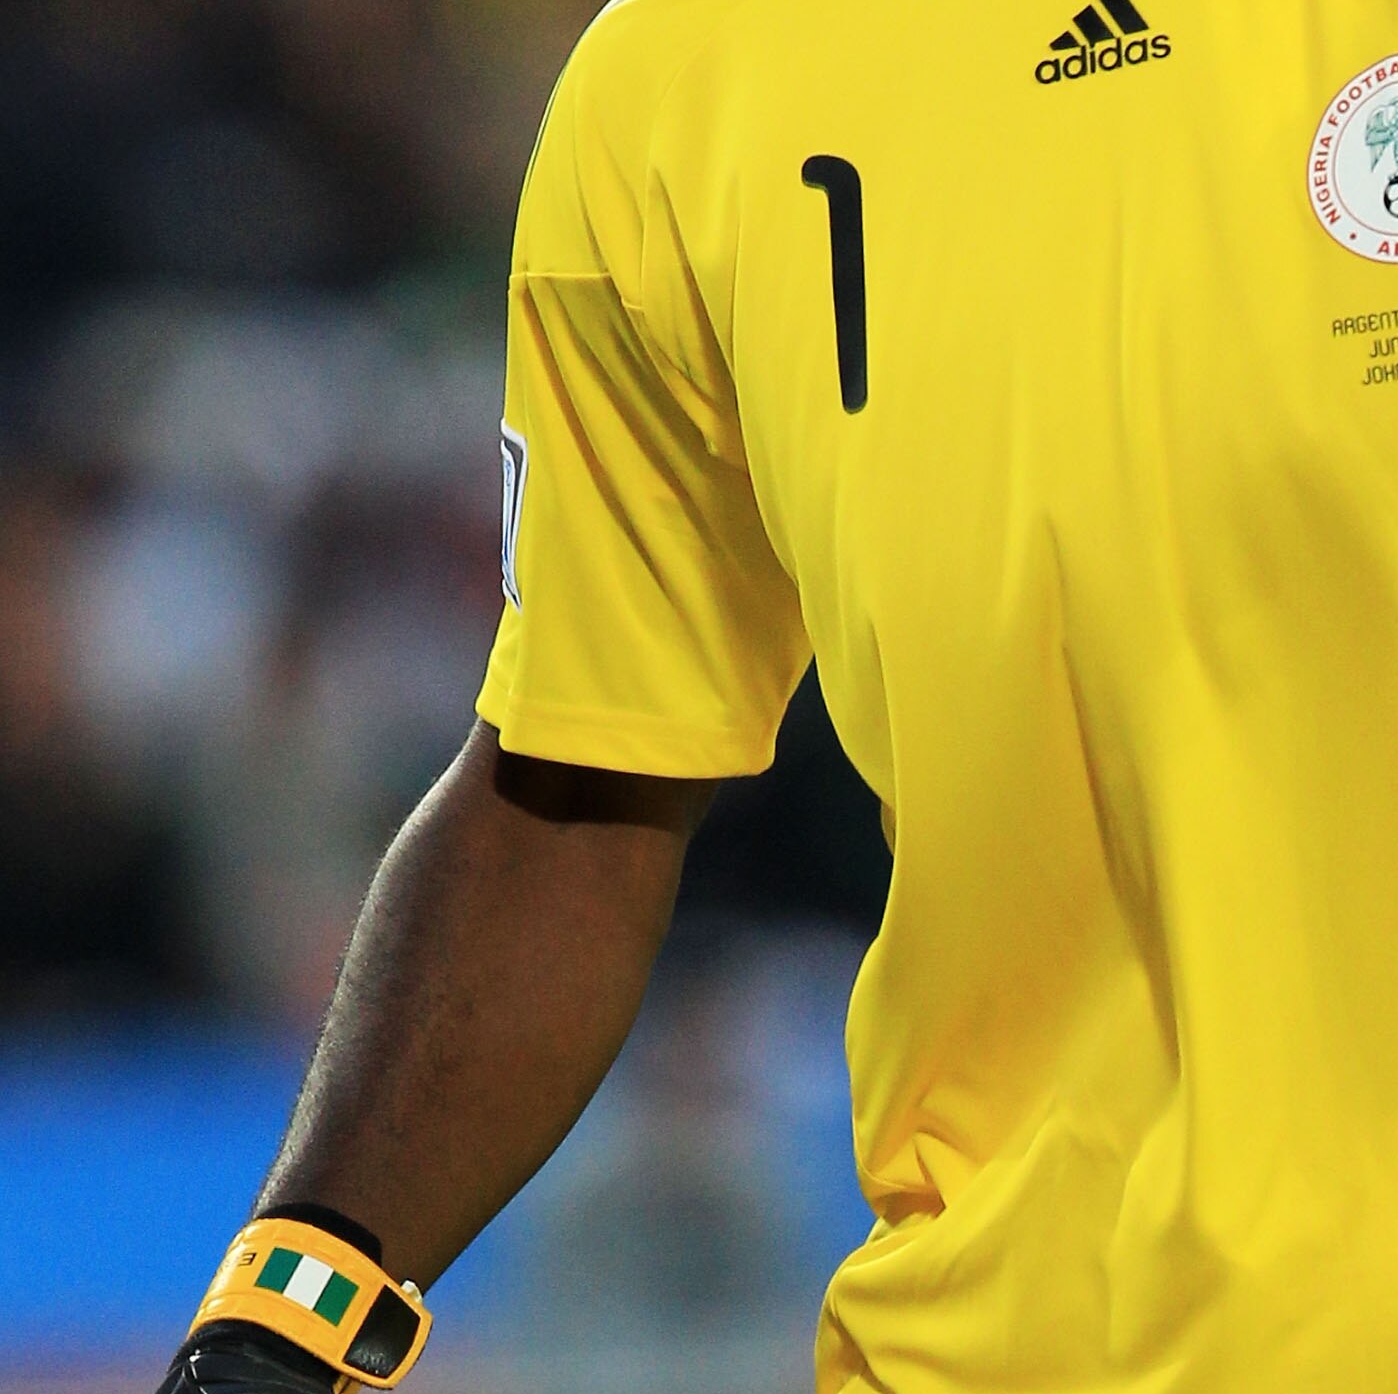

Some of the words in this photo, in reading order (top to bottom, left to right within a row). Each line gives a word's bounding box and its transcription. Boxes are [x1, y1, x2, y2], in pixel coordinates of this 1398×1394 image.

[1035, 35, 1171, 84] adidas
[1313, 135, 1341, 224] NIGERIA
[801, 154, 868, 414] 1
